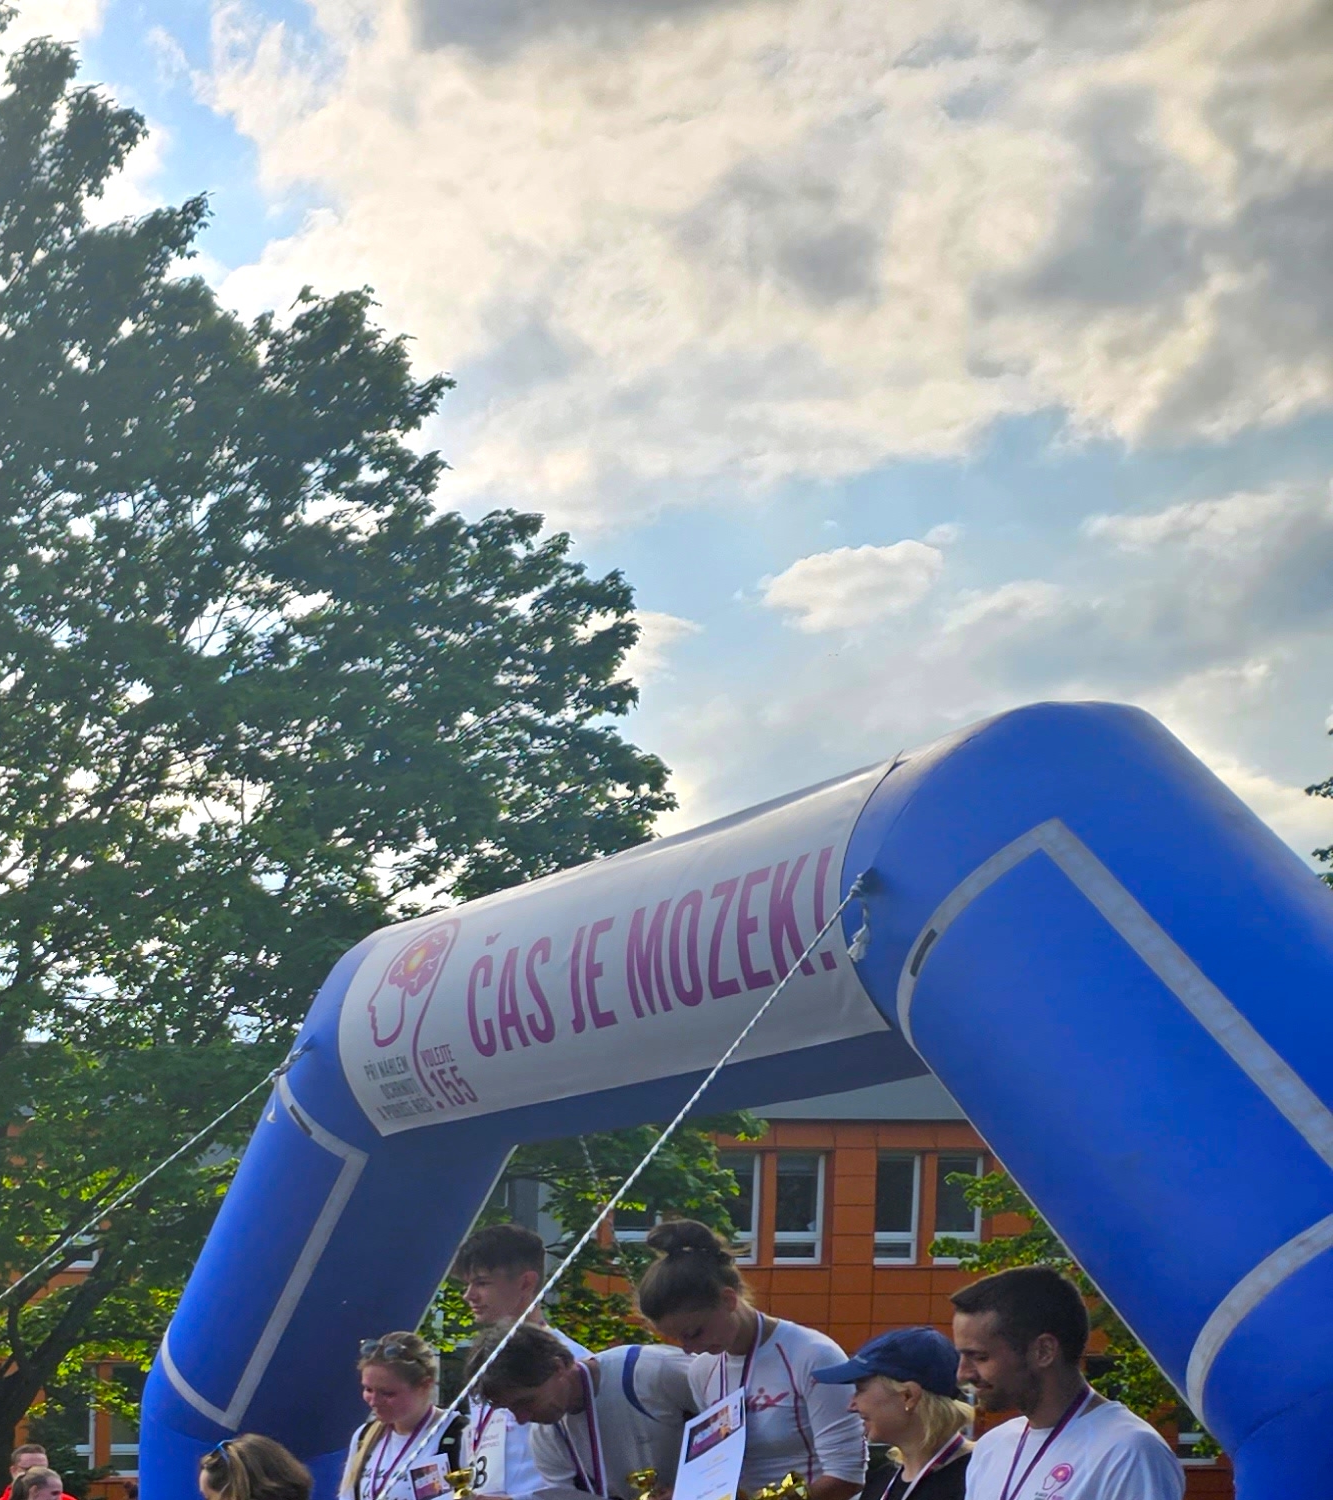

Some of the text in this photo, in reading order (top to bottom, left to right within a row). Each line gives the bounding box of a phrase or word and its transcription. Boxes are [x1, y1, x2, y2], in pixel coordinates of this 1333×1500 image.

[467, 847, 837, 1057] ČAS JE MOZEK!
[430, 1065, 478, 1107] 155
